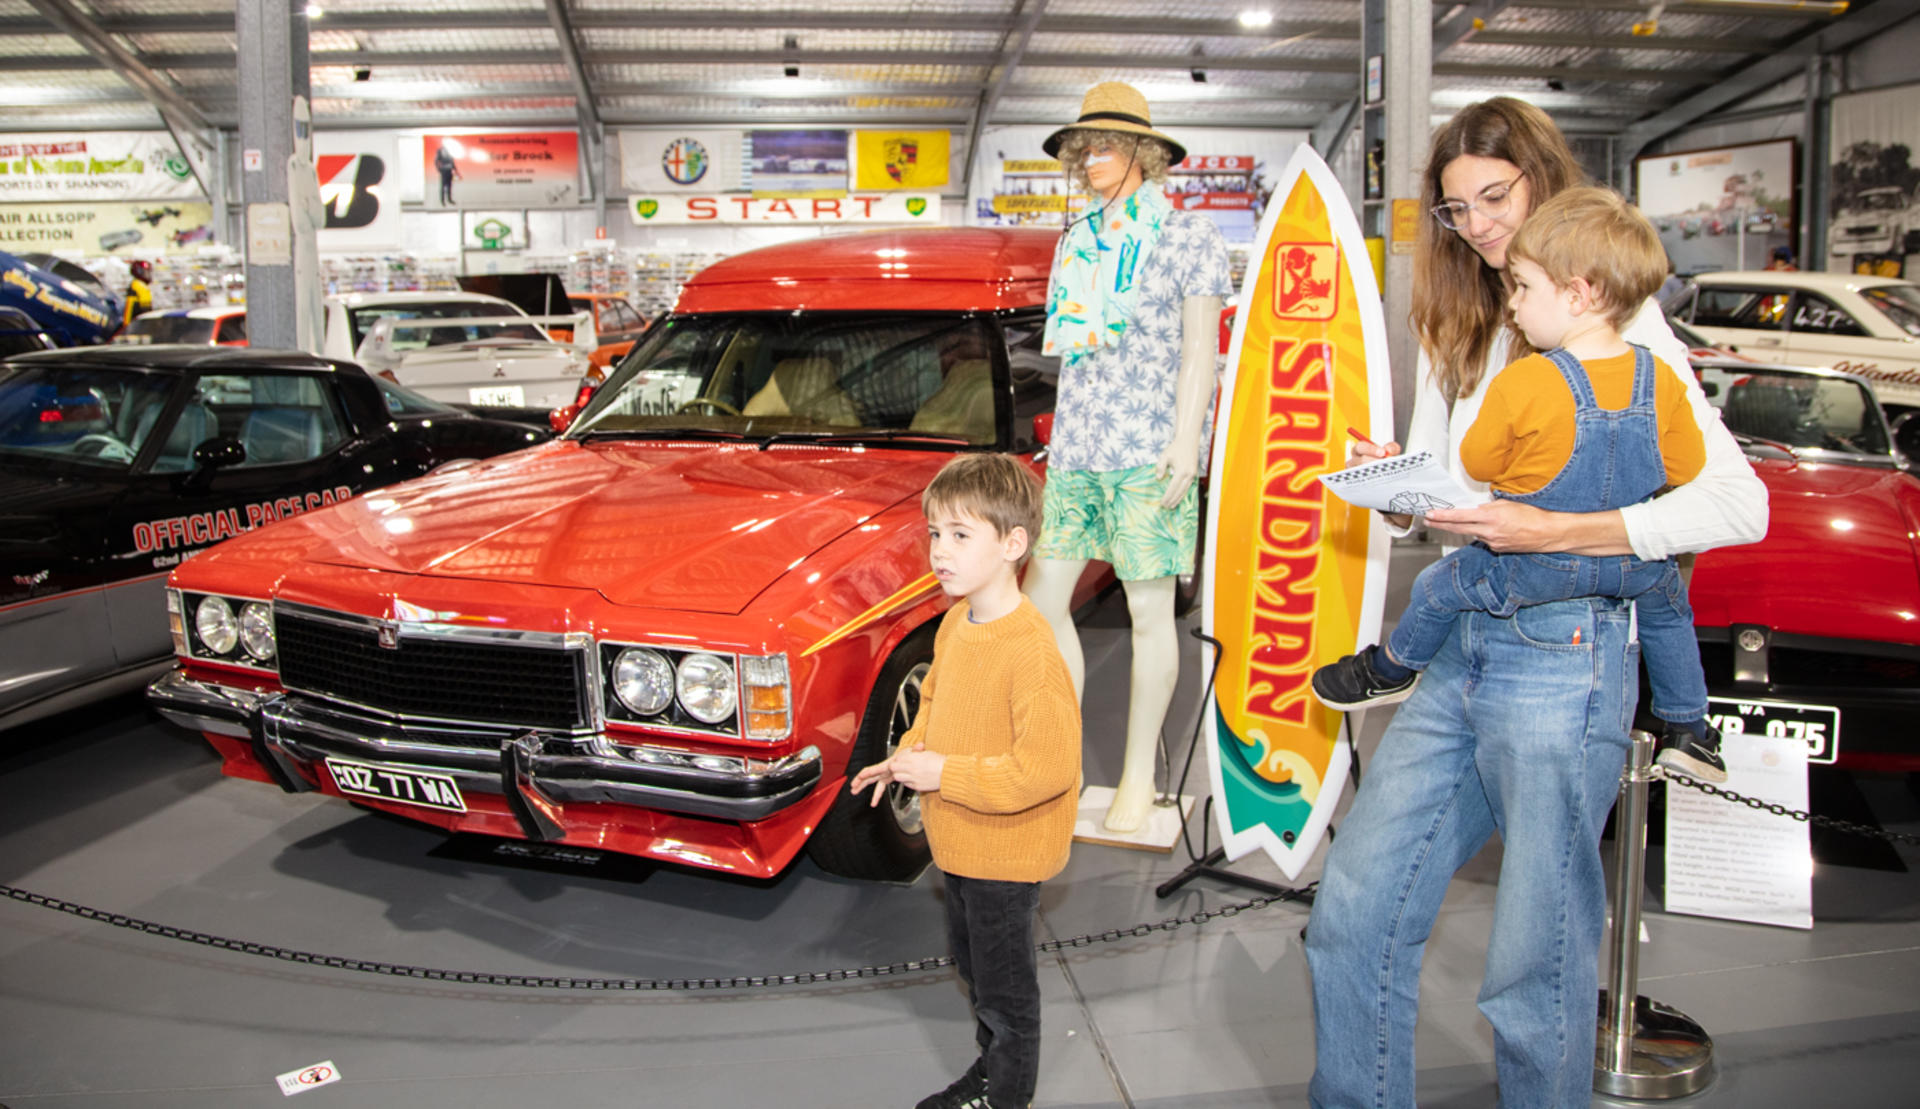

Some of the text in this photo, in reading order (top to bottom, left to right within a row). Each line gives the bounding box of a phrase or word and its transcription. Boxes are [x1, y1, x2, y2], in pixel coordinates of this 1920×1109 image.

[513, 150, 553, 160] Brock
[27, 212, 95, 223] ALLSOPP
[687, 195, 881, 220] START
[133, 508, 246, 552] OFFICIAL
[246, 496, 302, 528] PACE
[1244, 336, 1337, 729] SANDMAN
[1738, 703, 1765, 716] WA
[377, 771, 415, 800] 77
[417, 776, 461, 807] WA
